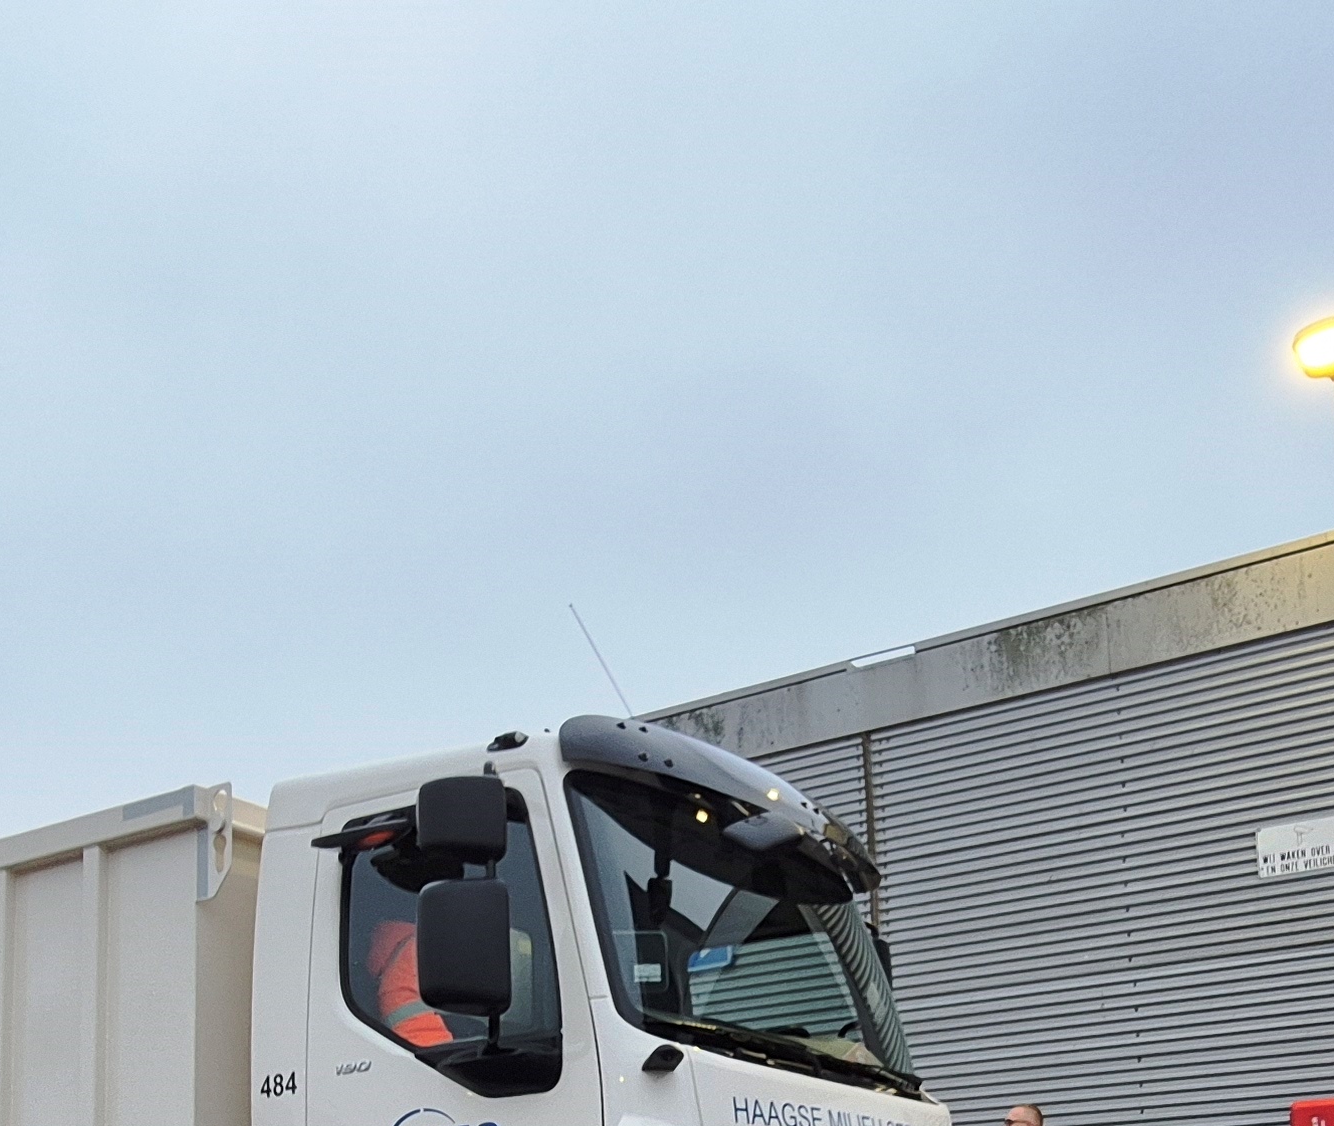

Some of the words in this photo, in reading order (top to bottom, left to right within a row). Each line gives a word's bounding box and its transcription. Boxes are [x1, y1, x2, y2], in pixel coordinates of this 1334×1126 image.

[1280, 849, 1306, 861] WAKEN
[1311, 844, 1331, 857] OVER
[1280, 860, 1299, 873] ONZE
[260, 1071, 298, 1098] 484
